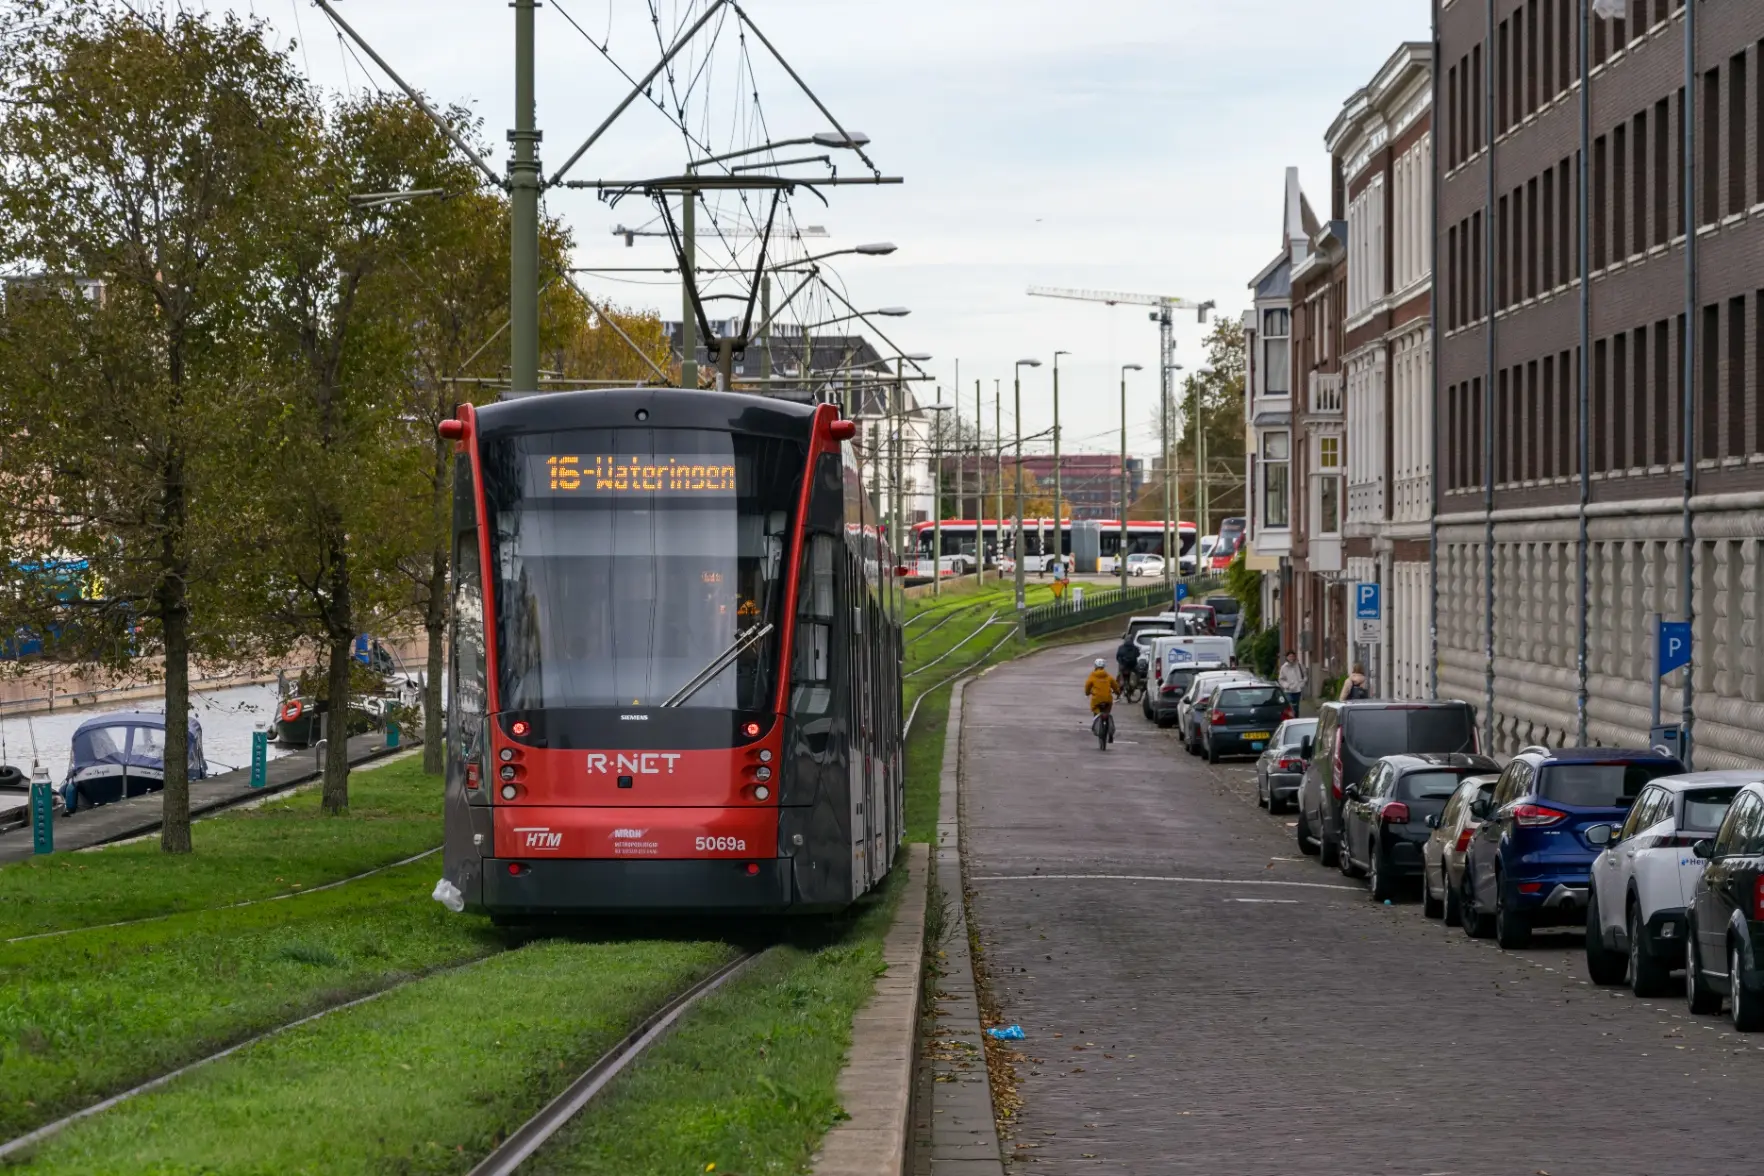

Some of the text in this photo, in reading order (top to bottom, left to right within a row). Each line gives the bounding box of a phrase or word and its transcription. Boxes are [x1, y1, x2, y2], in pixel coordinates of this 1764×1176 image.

[1361, 586, 1375, 604] P
[1669, 637, 1682, 658] P
[526, 832, 563, 847] HTM
[695, 836, 746, 851] 5069a
